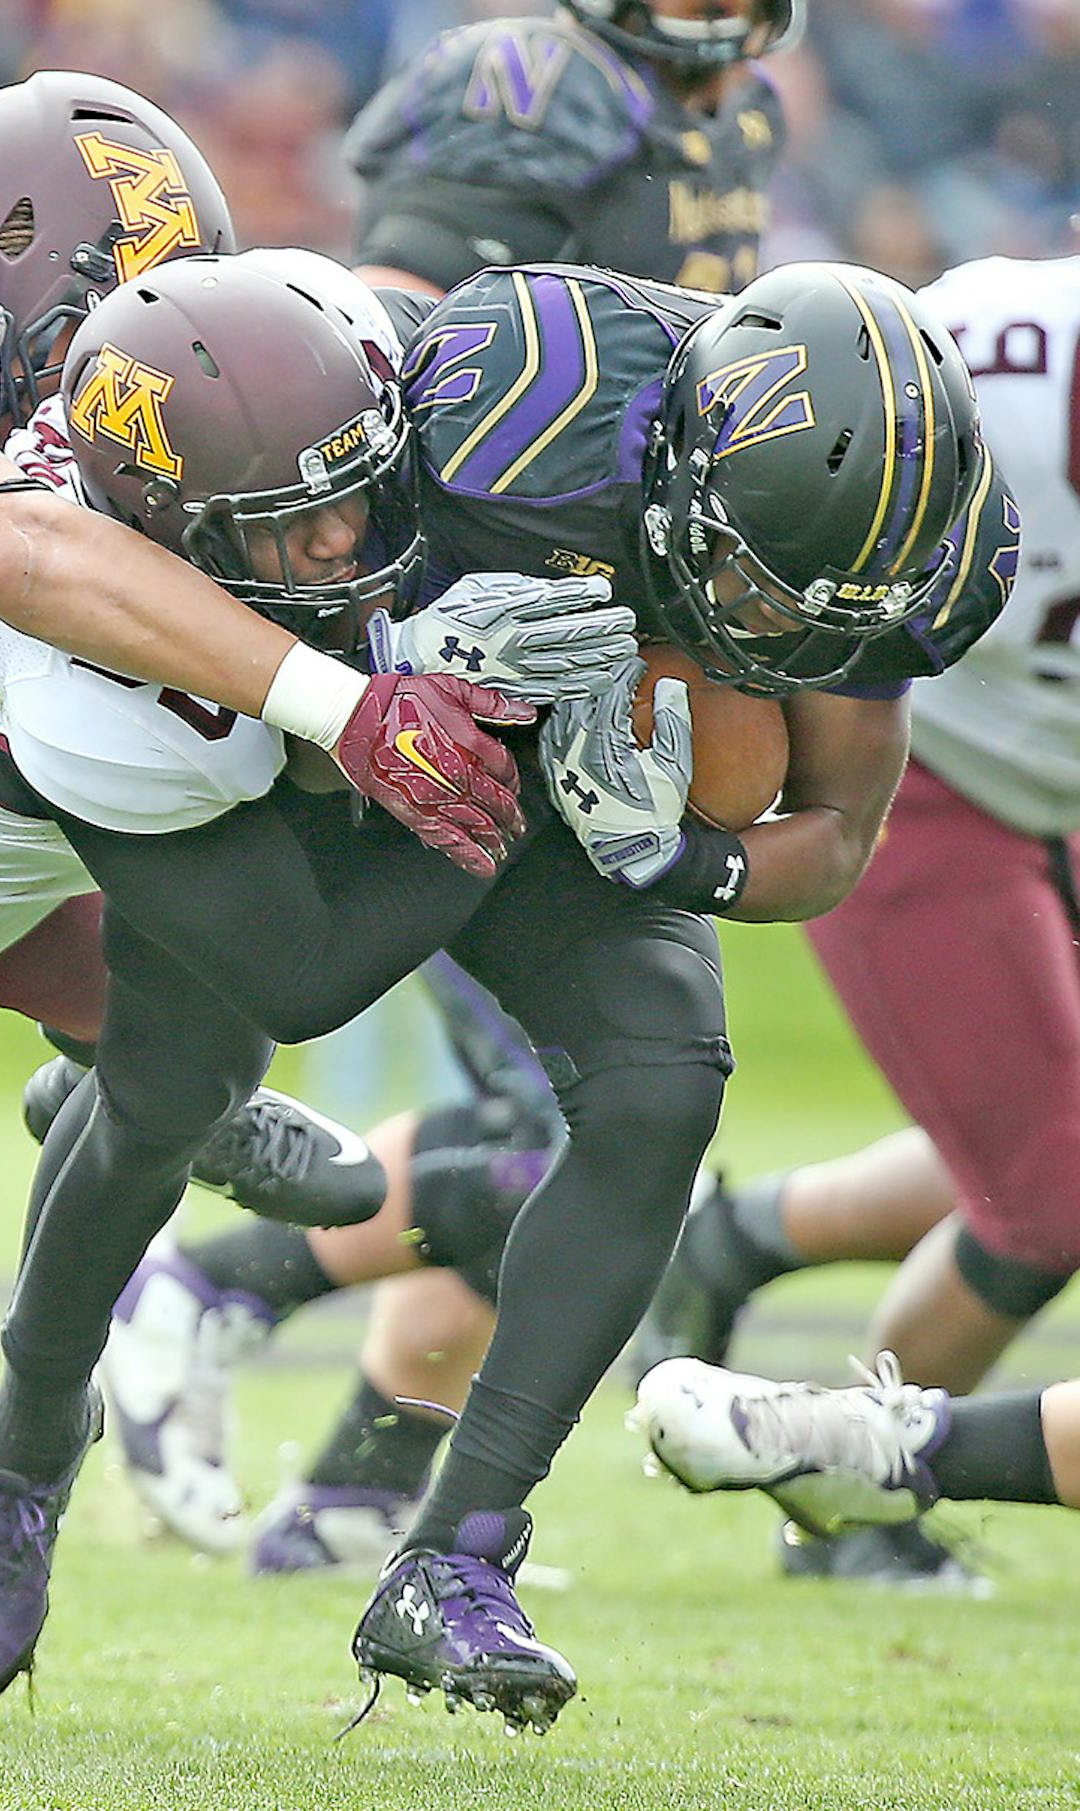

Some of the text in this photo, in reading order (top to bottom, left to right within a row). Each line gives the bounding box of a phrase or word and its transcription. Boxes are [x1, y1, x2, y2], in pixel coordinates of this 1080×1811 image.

[463, 30, 574, 131] N
[73, 130, 201, 285] M
[69, 341, 185, 482] M
[320, 422, 366, 462] TEAM
[696, 344, 816, 461] N
